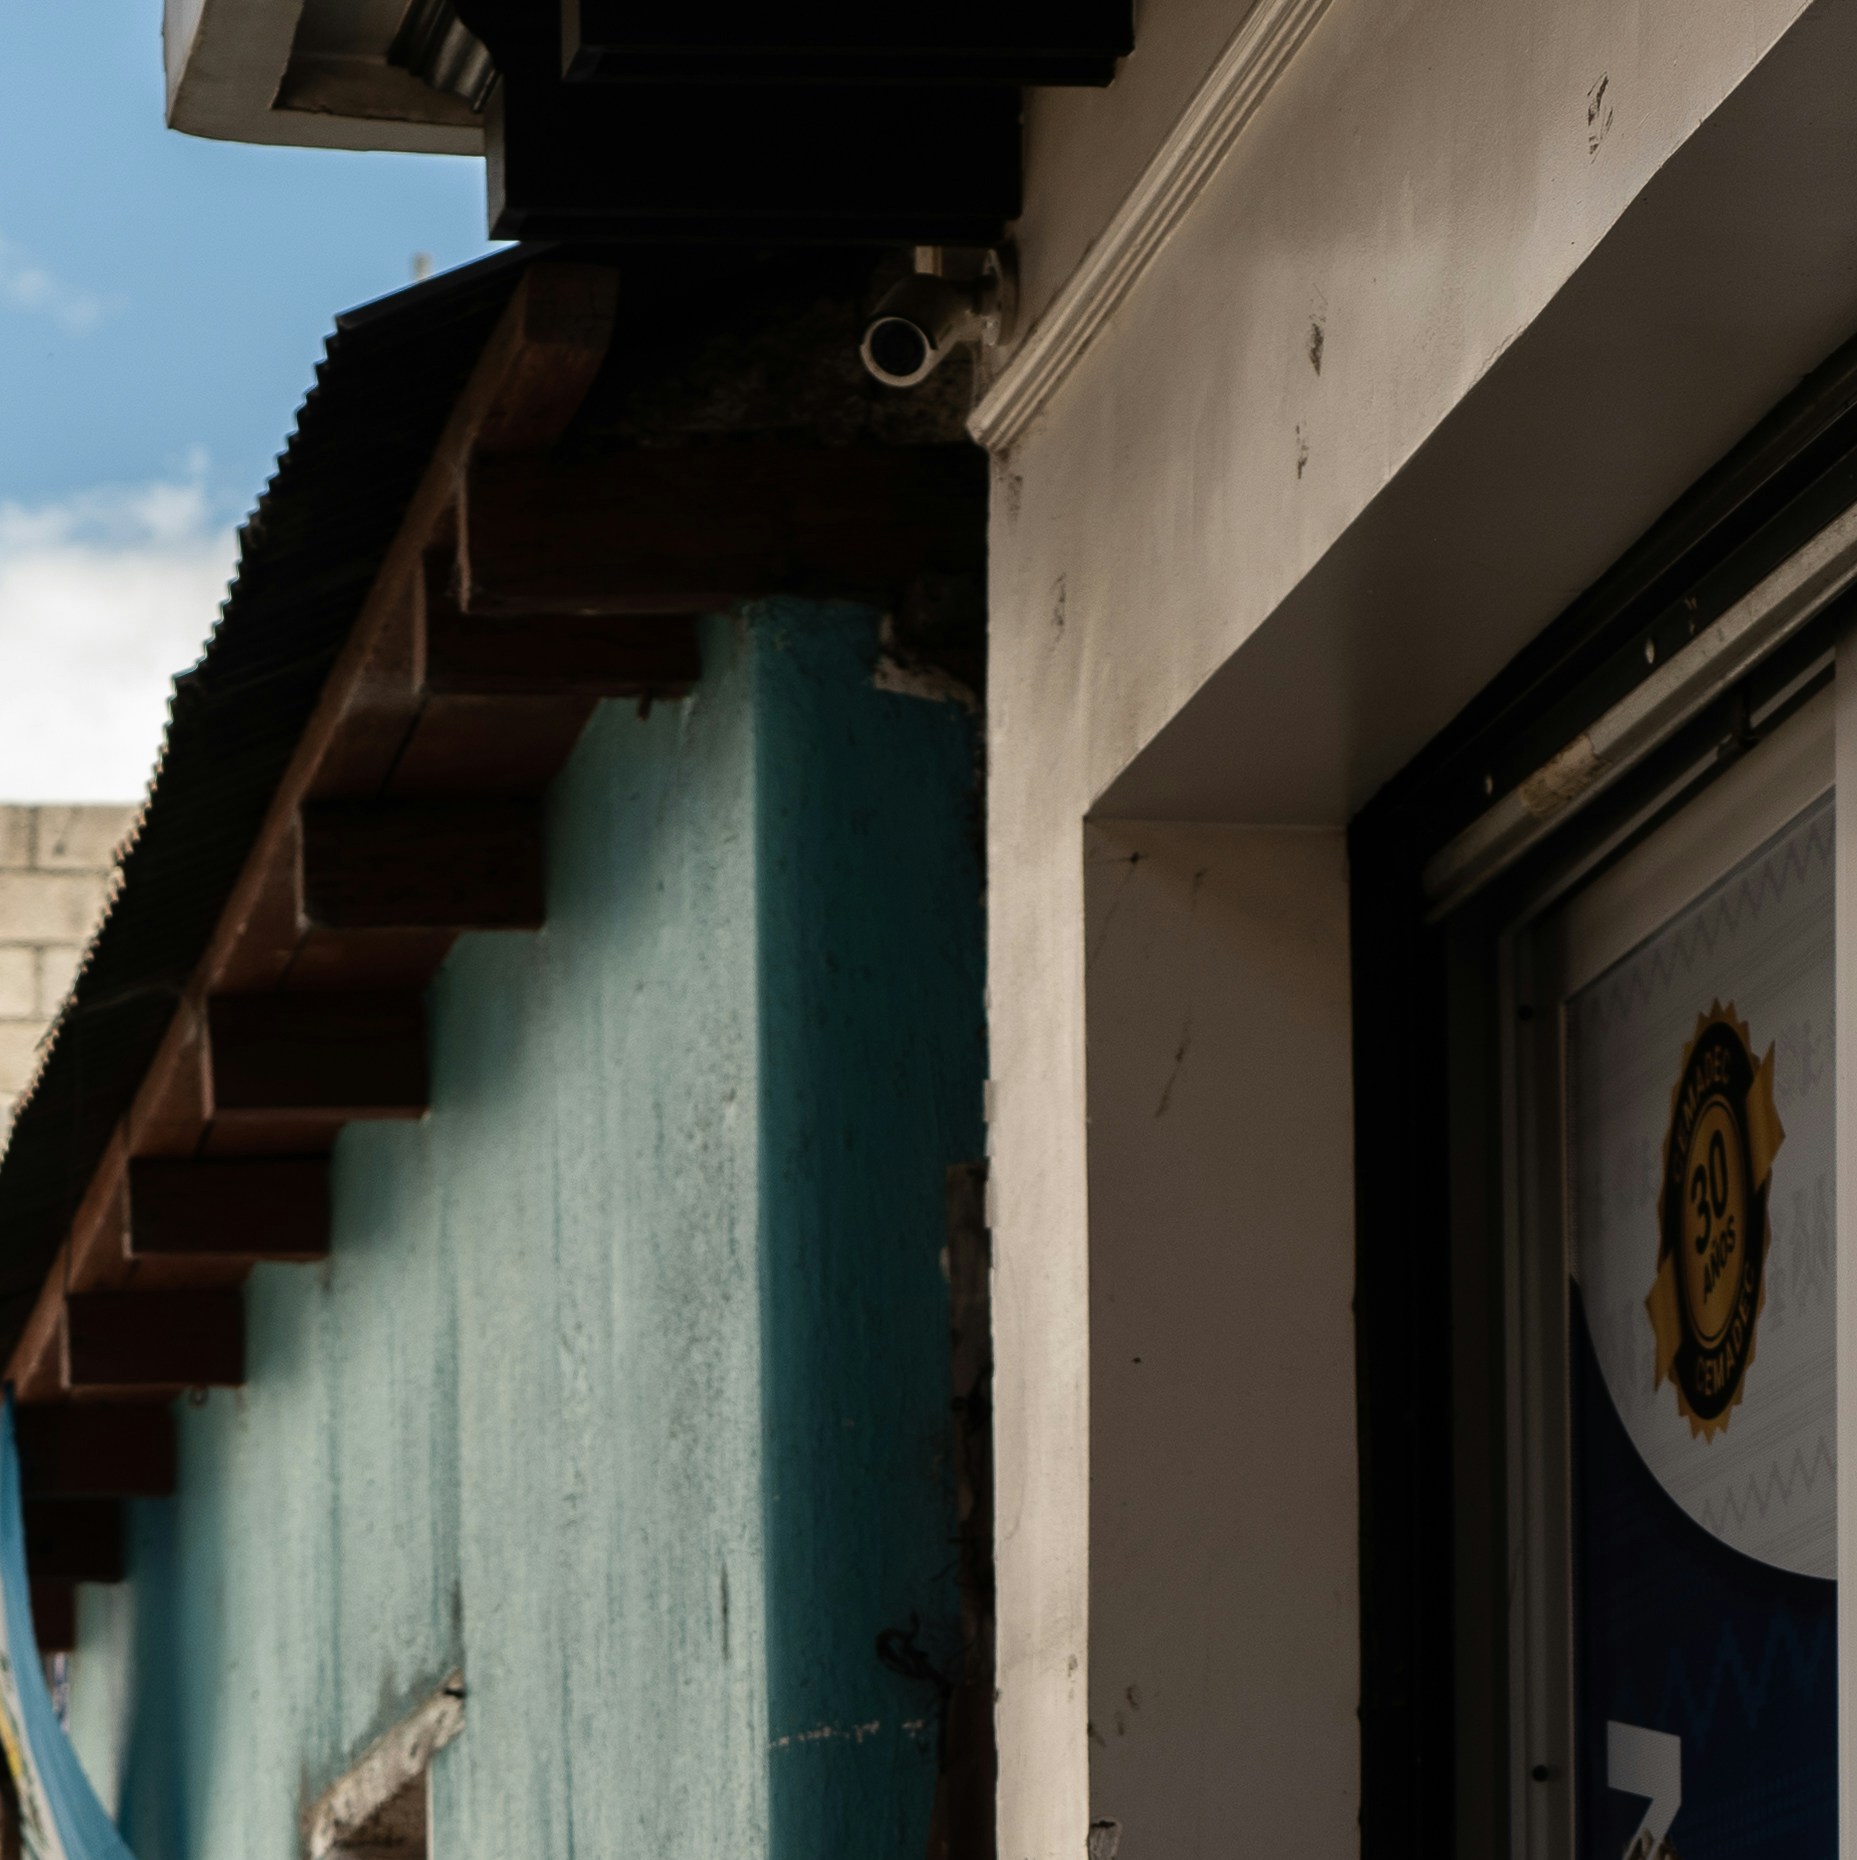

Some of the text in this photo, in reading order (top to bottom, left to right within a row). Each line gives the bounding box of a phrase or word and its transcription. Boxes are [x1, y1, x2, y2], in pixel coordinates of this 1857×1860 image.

[1691, 1129, 1729, 1255] 30
[1703, 1216, 1736, 1305] AÑOS
[1693, 1261, 1755, 1397] CEMADEC
